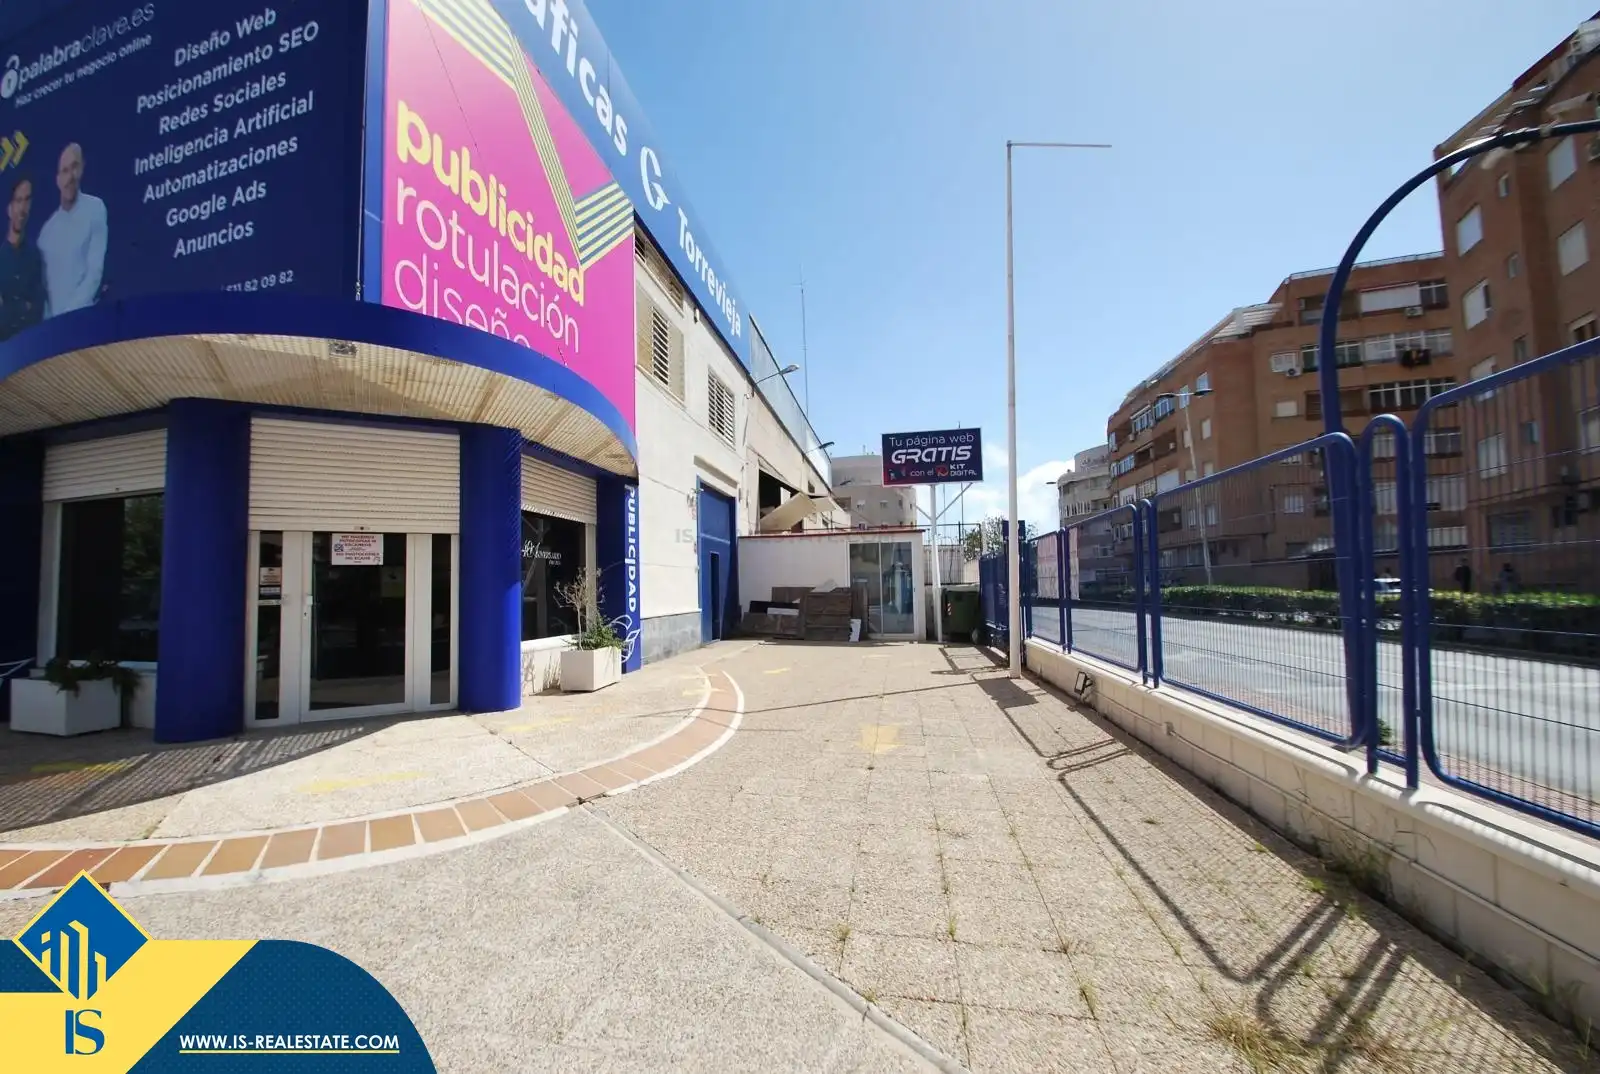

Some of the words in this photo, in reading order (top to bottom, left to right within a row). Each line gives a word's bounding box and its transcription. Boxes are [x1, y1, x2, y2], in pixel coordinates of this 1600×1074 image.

[18, 3, 155, 90] palabraclave.es
[76, 52, 117, 78] negocio
[118, 34, 152, 57] online
[136, 43, 273, 114] Posicionamiento
[279, 20, 319, 53] SEO
[174, 28, 231, 67] Diseño
[236, 7, 277, 39] Web
[134, 127, 228, 176] Inteligencia
[234, 91, 314, 139] Artificial
[159, 103, 208, 135] Redes
[213, 70, 287, 113] Sociales
[143, 136, 298, 204] Automatizaciones
[166, 196, 226, 228] Google
[232, 180, 267, 207] Ads
[397, 100, 584, 307] publicidad
[173, 220, 254, 259] Anuncios
[397, 177, 579, 353] rotulación
[244, 279, 258, 292] 82
[260, 274, 276, 288] 09
[279, 269, 294, 284] 82
[678, 207, 742, 339] Torrevieja
[888, 436, 903, 447] Tu
[906, 434, 946, 448] página
[949, 432, 975, 443] web
[891, 445, 972, 464] GRATIS
[624, 484, 637, 613] PUBLICIDAD
